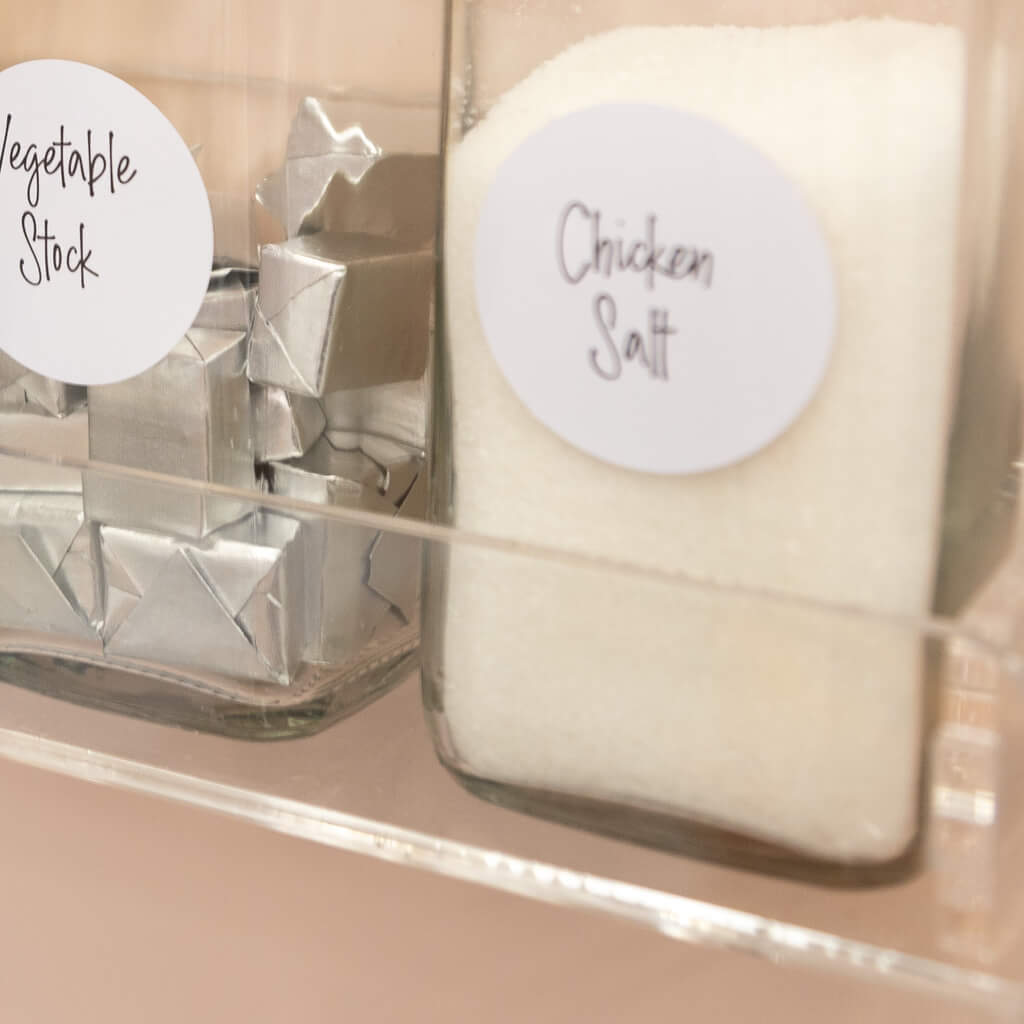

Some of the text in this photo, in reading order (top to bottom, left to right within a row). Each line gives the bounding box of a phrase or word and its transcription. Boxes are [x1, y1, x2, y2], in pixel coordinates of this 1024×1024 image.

[19, 211, 99, 289] Stock
[556, 199, 714, 290] Chicken
[588, 291, 677, 381] Salt
